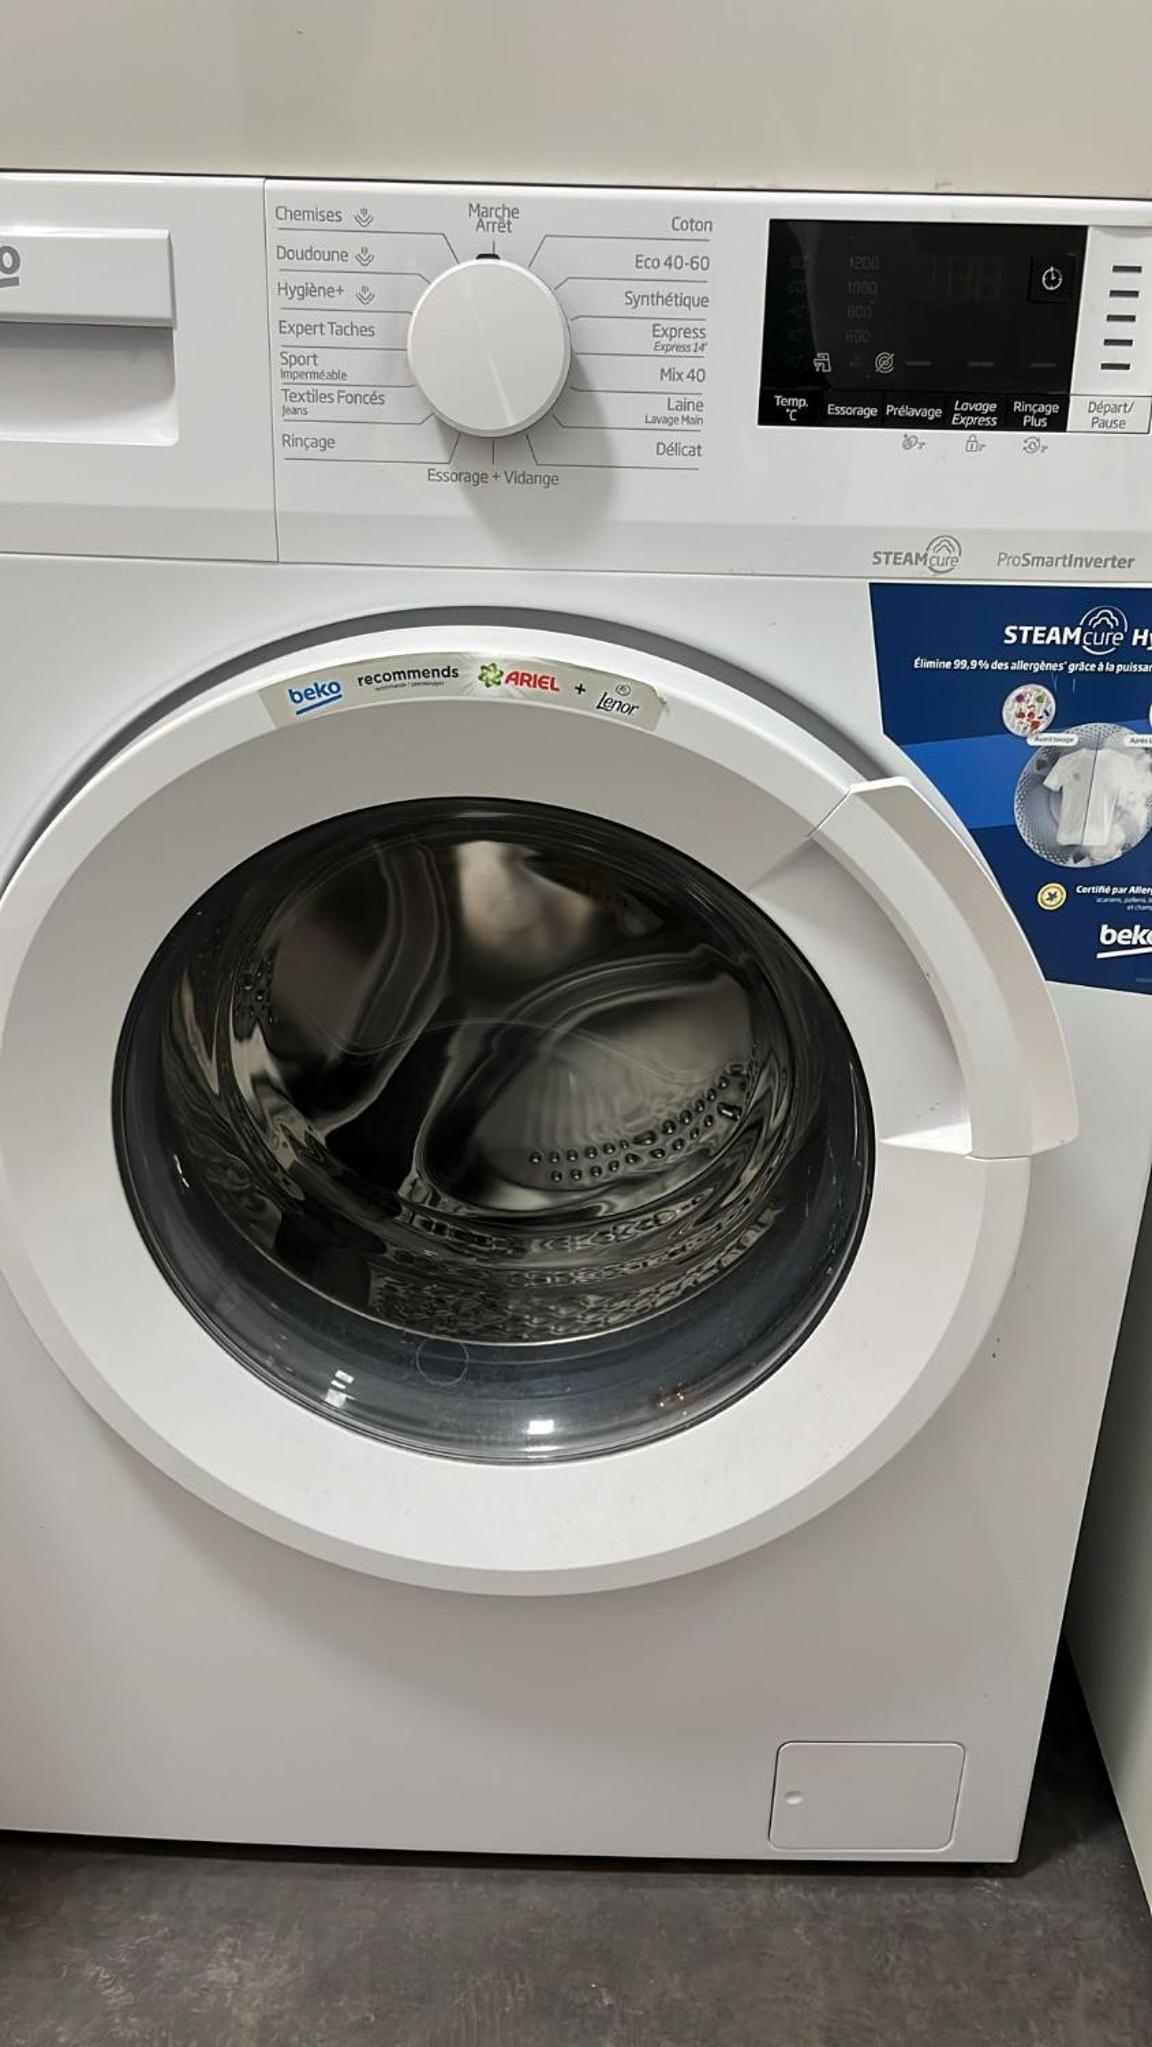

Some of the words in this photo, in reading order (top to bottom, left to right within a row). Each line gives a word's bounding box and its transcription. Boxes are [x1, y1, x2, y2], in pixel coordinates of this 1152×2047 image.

[275, 205, 342, 223] Chemises
[468, 203, 520, 219] Marche
[475, 216, 513, 233] Arrêt
[671, 216, 713, 232] Coton
[276, 245, 348, 262] Doudoune
[635, 254, 660, 269] Eco
[663, 254, 710, 271] 40-60
[277, 281, 344, 301] Hygiène+
[624, 290, 710, 311] Synthétique
[279, 320, 325, 338] Expert
[327, 321, 375, 337] Taches
[652, 323, 707, 341] Express
[654, 341, 691, 354] Express
[280, 351, 319, 368] Sport
[280, 368, 348, 381] Imperméable
[660, 367, 684, 382] Mix
[686, 368, 706, 382] 40
[280, 388, 335, 404] Textiles
[336, 390, 385, 405] Foncés
[667, 397, 704, 412] Laine
[774, 395, 809, 409] Temp.
[281, 404, 308, 417] Jeans
[786, 408, 798, 421] °C
[827, 403, 878, 419] Essorage
[886, 404, 943, 420] Prélavage
[954, 400, 998, 414] Lavage
[1013, 401, 1060, 415] Rinçage
[1087, 401, 1135, 415] Départ/
[645, 414, 679, 427] Lavage
[680, 414, 704, 425] Main
[951, 413, 998, 428] Express
[1023, 414, 1048, 428] Plus
[1091, 417, 1127, 430] Pause
[282, 433, 336, 451] Rinçage
[656, 442, 702, 457] Délicat
[427, 469, 488, 484] Essorage
[492, 472, 501, 482] +
[504, 471, 560, 488] Vidange
[997, 552, 1136, 569] ProSmartInverter
[913, 656, 952, 670] Élimine
[991, 661, 1009, 671] des
[1068, 660, 1096, 674] grâce
[1097, 660, 1104, 672] à
[1105, 661, 1115, 672] la
[288, 679, 342, 706] beko
[357, 665, 459, 687] recommends
[505, 670, 560, 692] ARIEL
[574, 683, 586, 695] +
[596, 691, 640, 716] Lenor
[1075, 885, 1111, 894] Certifié
[1111, 886, 1128, 895] par
